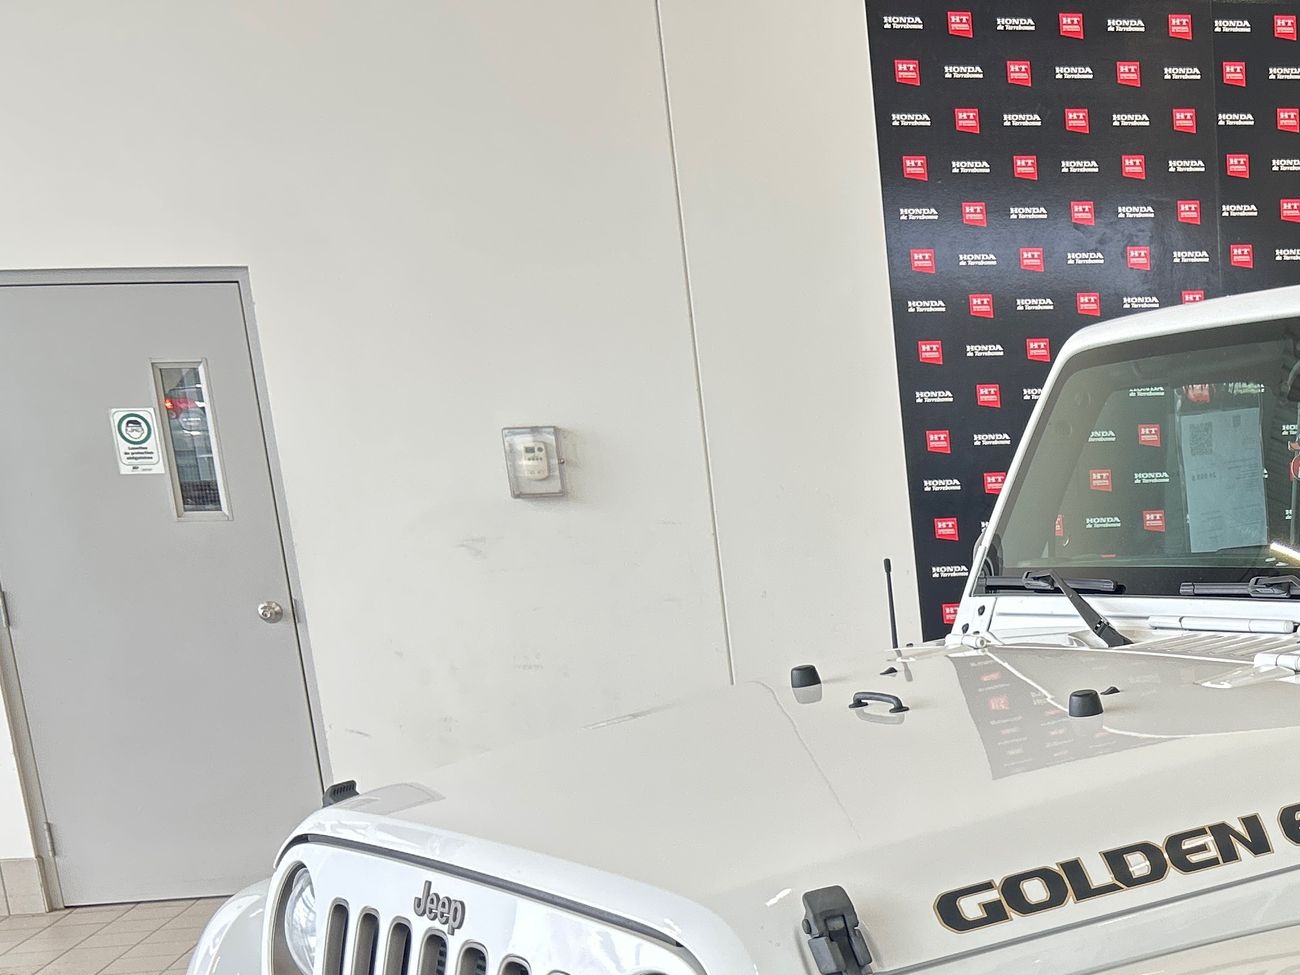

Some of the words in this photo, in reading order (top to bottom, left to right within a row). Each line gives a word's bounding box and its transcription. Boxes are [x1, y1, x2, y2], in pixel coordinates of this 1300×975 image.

[883, 16, 922, 24] HONDA
[1107, 19, 1144, 27] HONDA
[933, 812, 1275, 934] GOLDEN
[414, 880, 465, 936] Jeep
